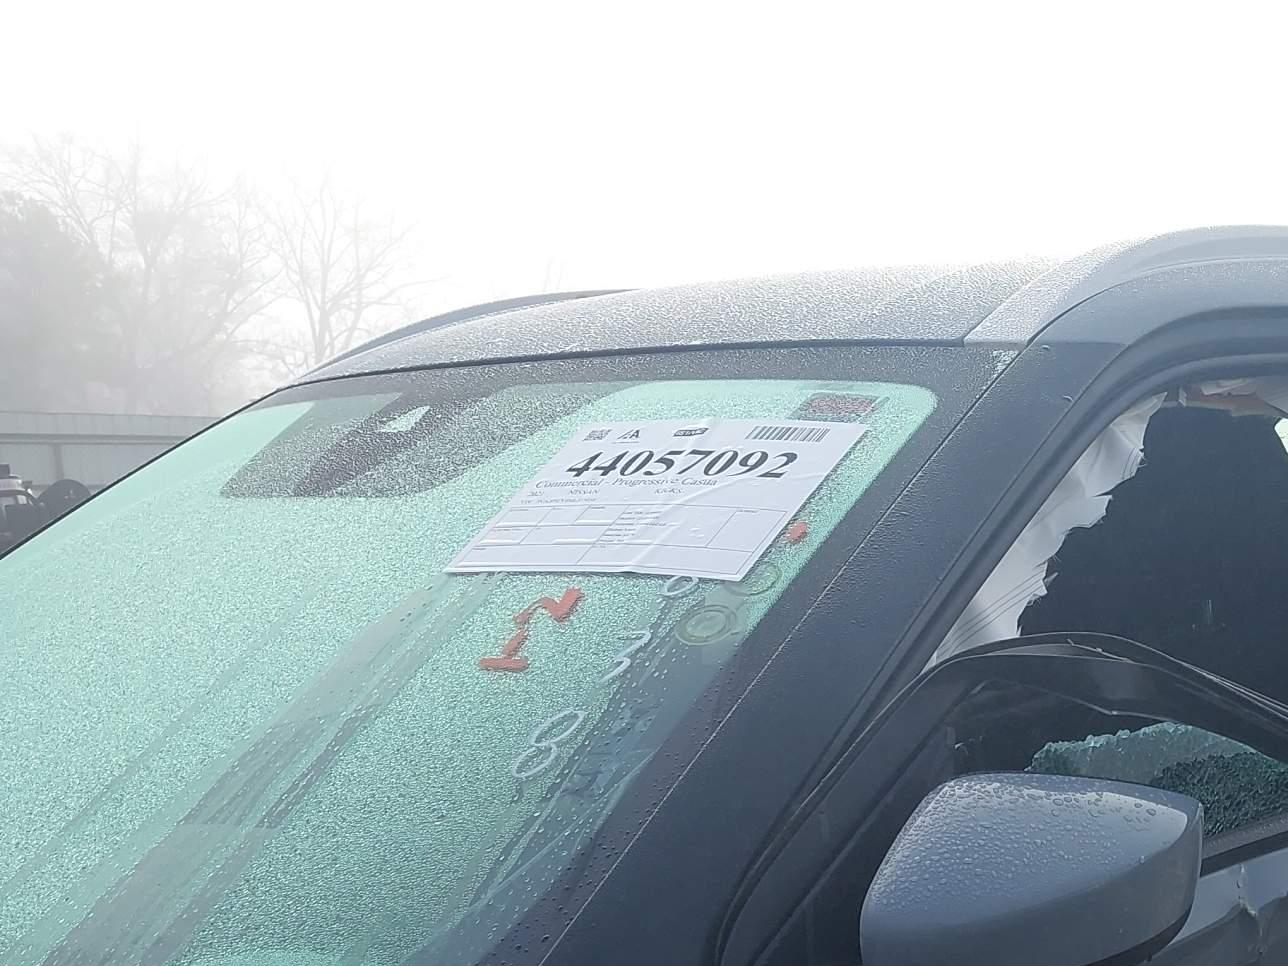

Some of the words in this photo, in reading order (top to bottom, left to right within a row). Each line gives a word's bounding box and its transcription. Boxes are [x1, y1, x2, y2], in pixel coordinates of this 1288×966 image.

[565, 449, 798, 479] 44057092
[535, 477, 604, 489] Commercial
[611, 477, 680, 488] Progressive
